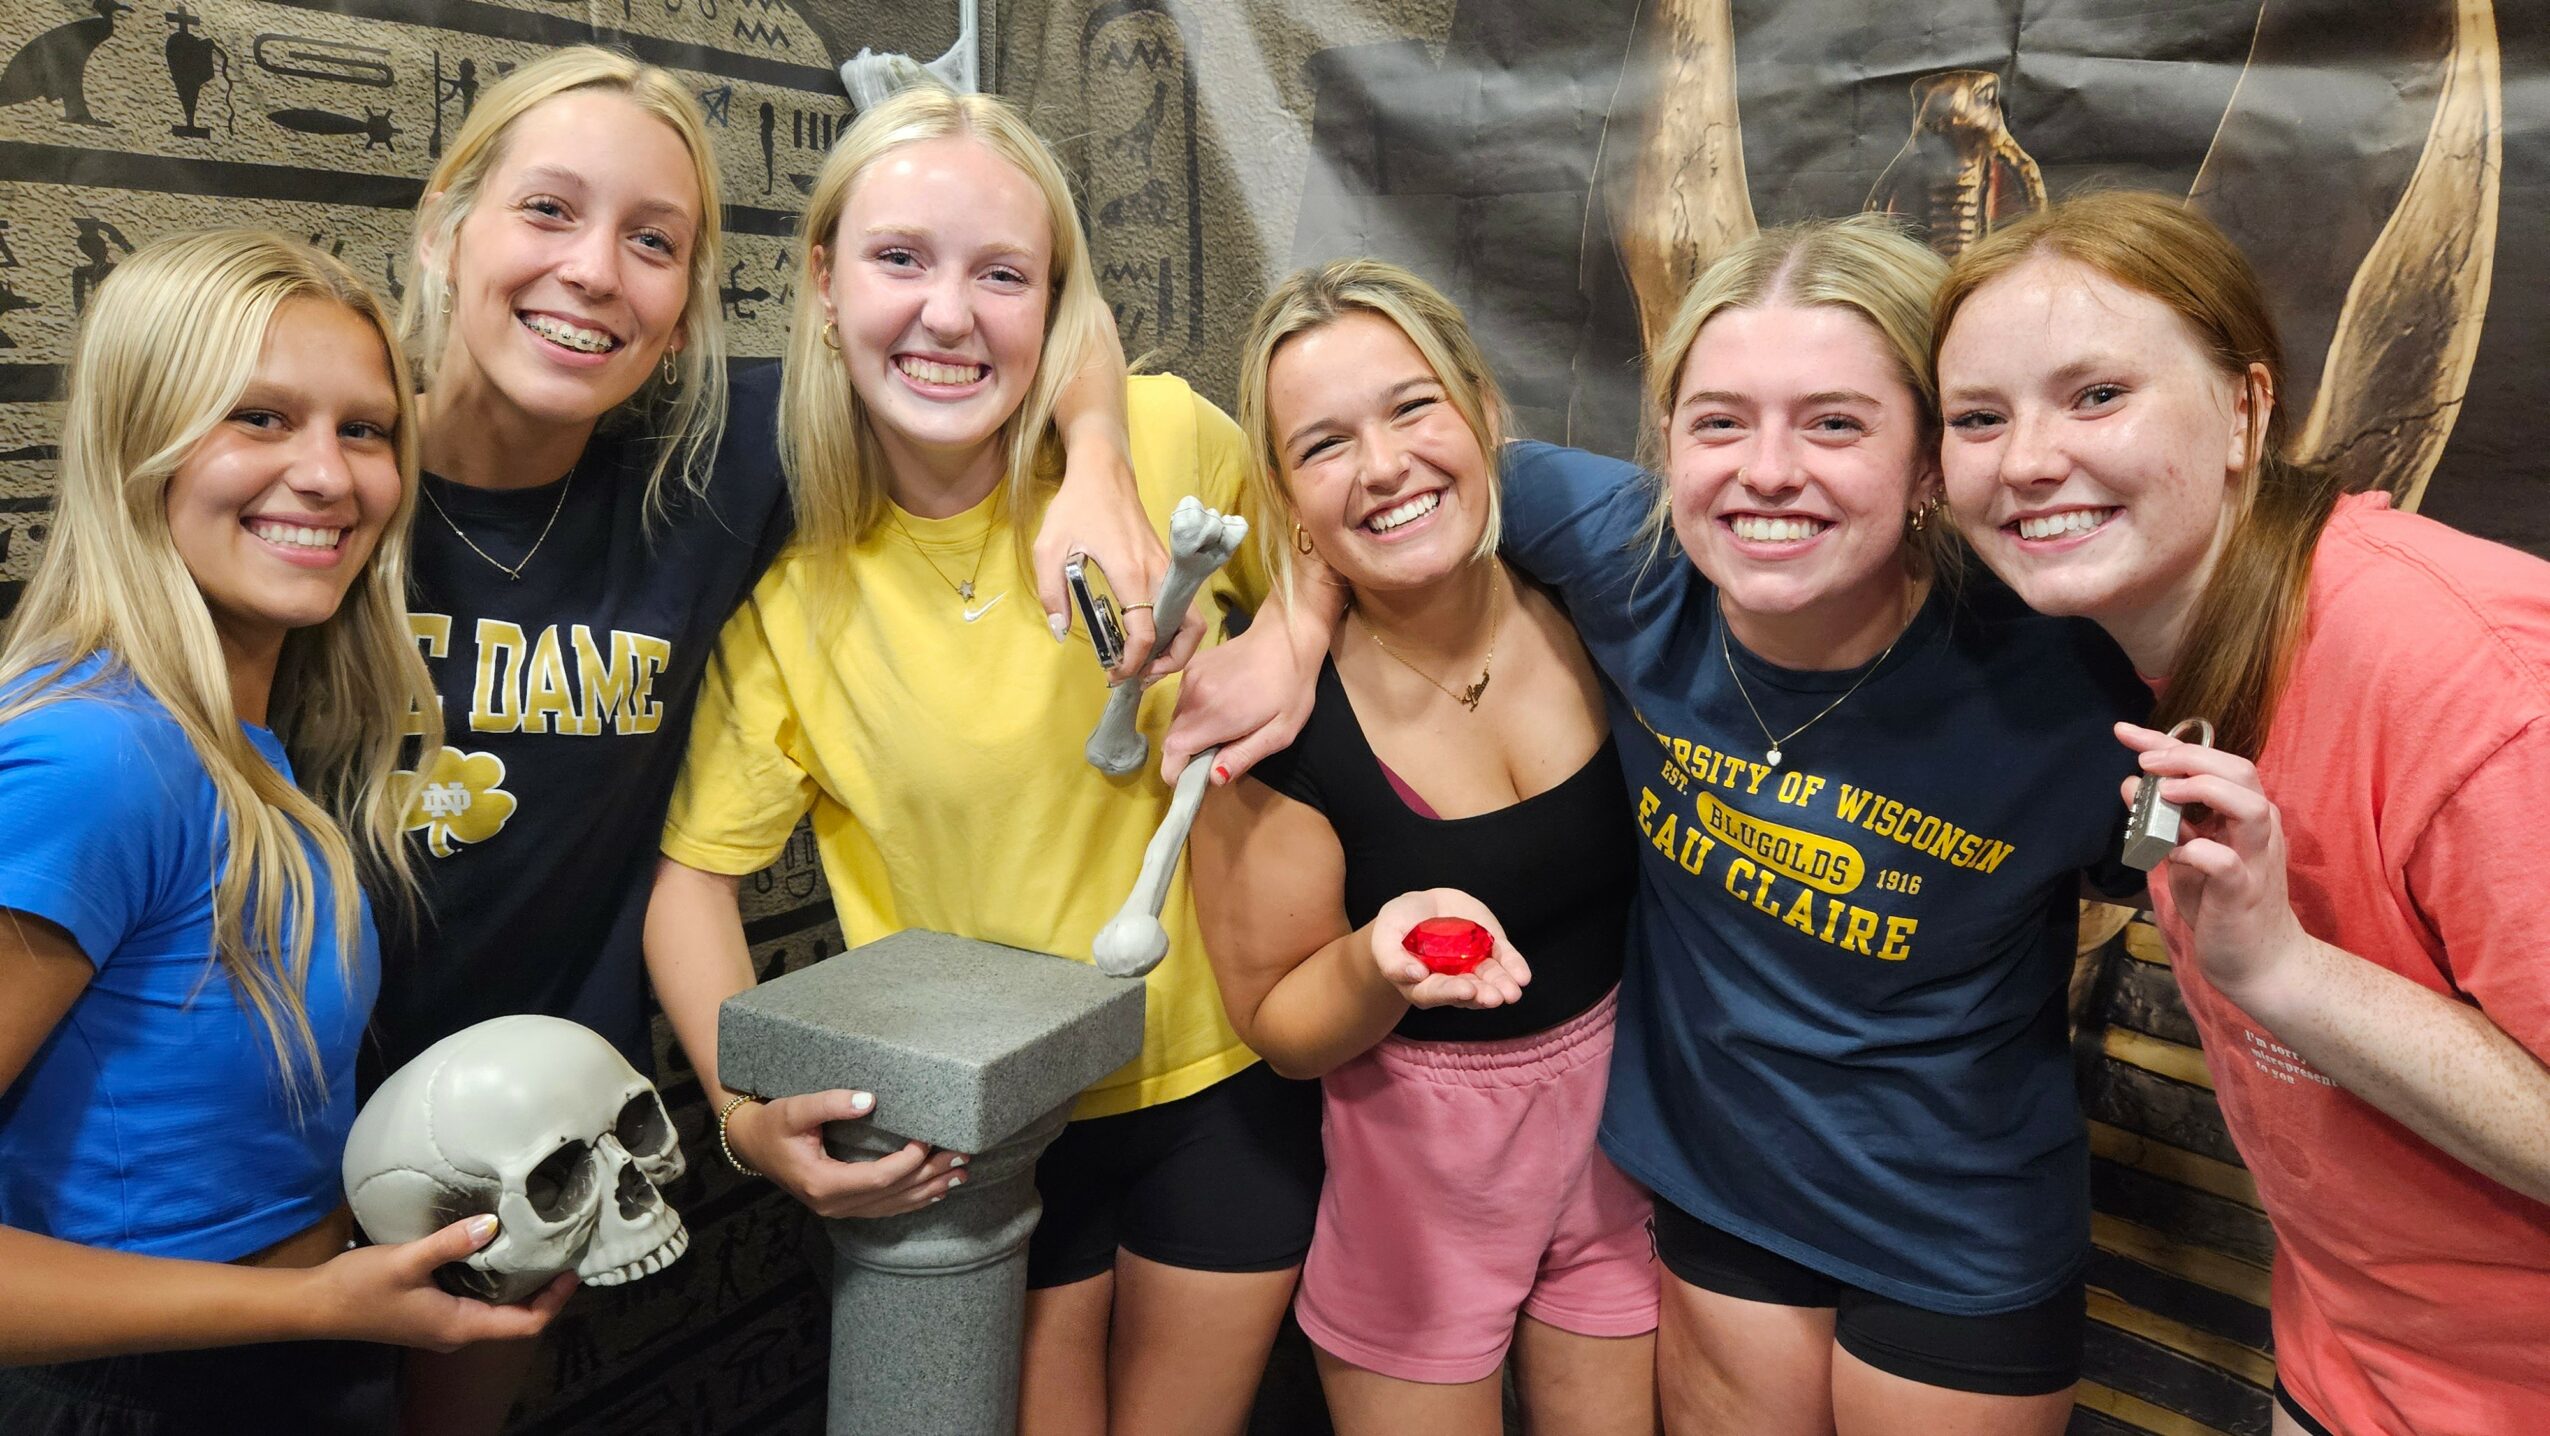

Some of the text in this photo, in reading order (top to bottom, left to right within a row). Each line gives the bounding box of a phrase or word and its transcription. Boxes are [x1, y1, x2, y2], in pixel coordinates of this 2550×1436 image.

[469, 618, 671, 736] DAME
[1661, 760, 1688, 796] EST.
[1710, 804, 1850, 886] BLUGOLDS
[1777, 771, 1826, 807] OF
[1836, 783, 2015, 874] WISCONSIN
[1638, 786, 1919, 961] EAU CLAIRE
[1876, 869, 1922, 895] 1916
[2244, 1029, 2267, 1049] I'm
[2256, 1060, 2296, 1085] to you
